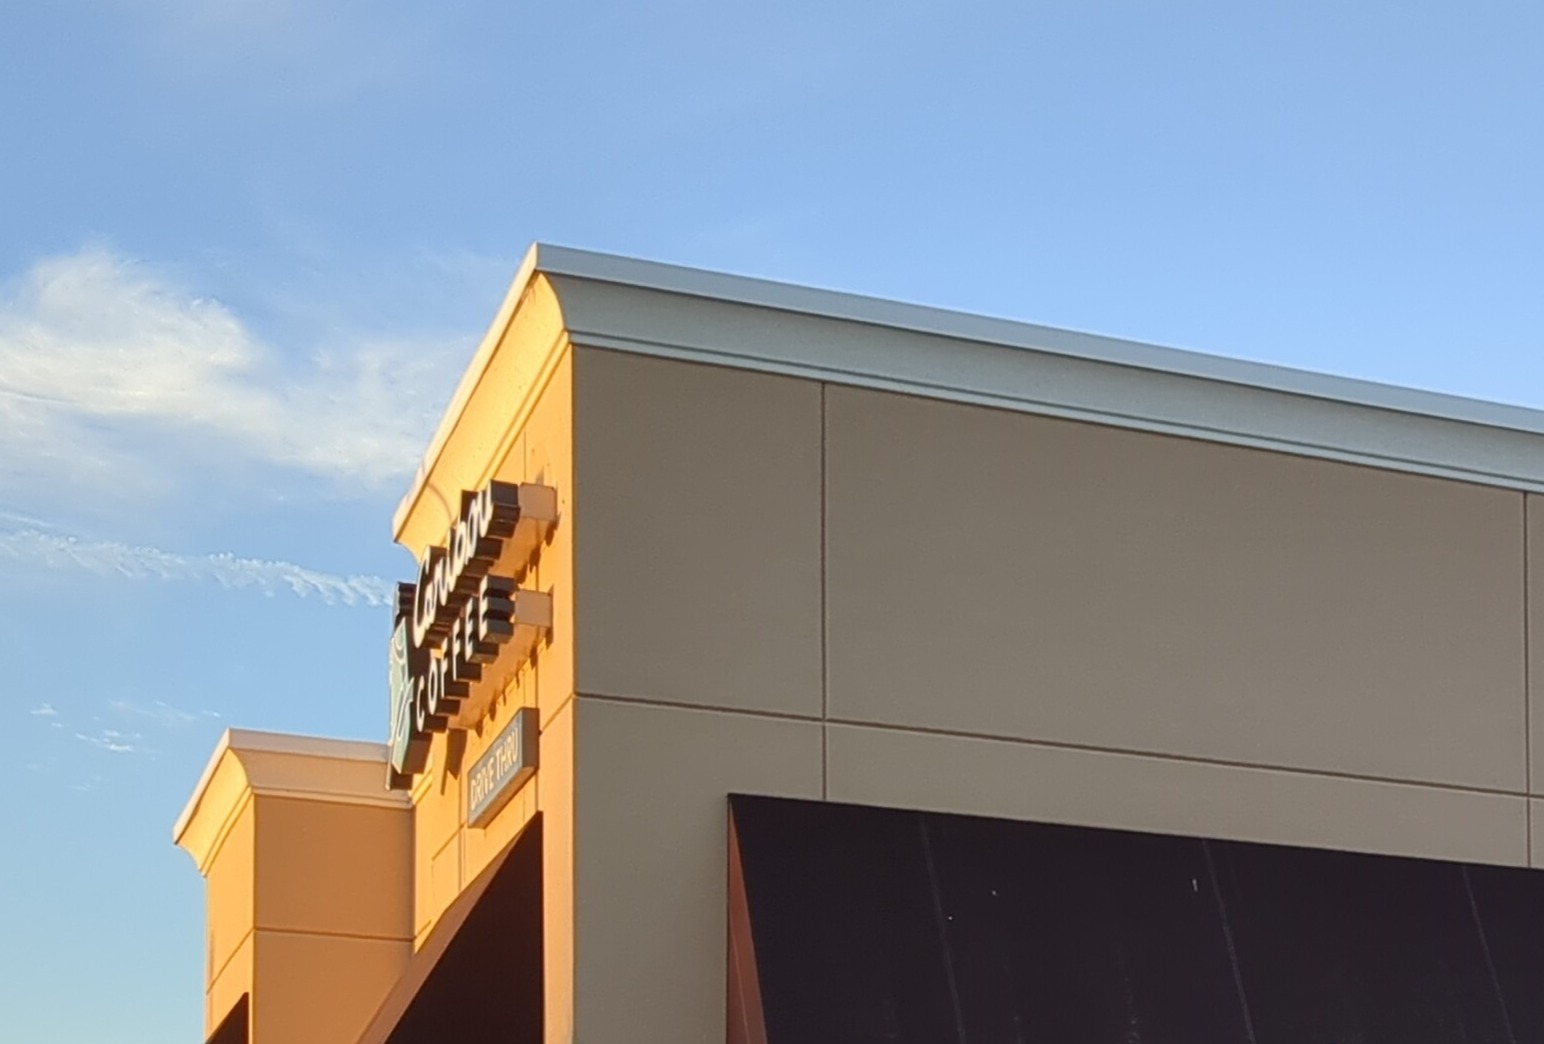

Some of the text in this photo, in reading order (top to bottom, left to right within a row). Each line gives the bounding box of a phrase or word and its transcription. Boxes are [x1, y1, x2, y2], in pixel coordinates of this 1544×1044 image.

[413, 479, 493, 649] Caribou
[417, 574, 489, 733] COFFEE
[471, 727, 519, 812] DRIVE THRU
